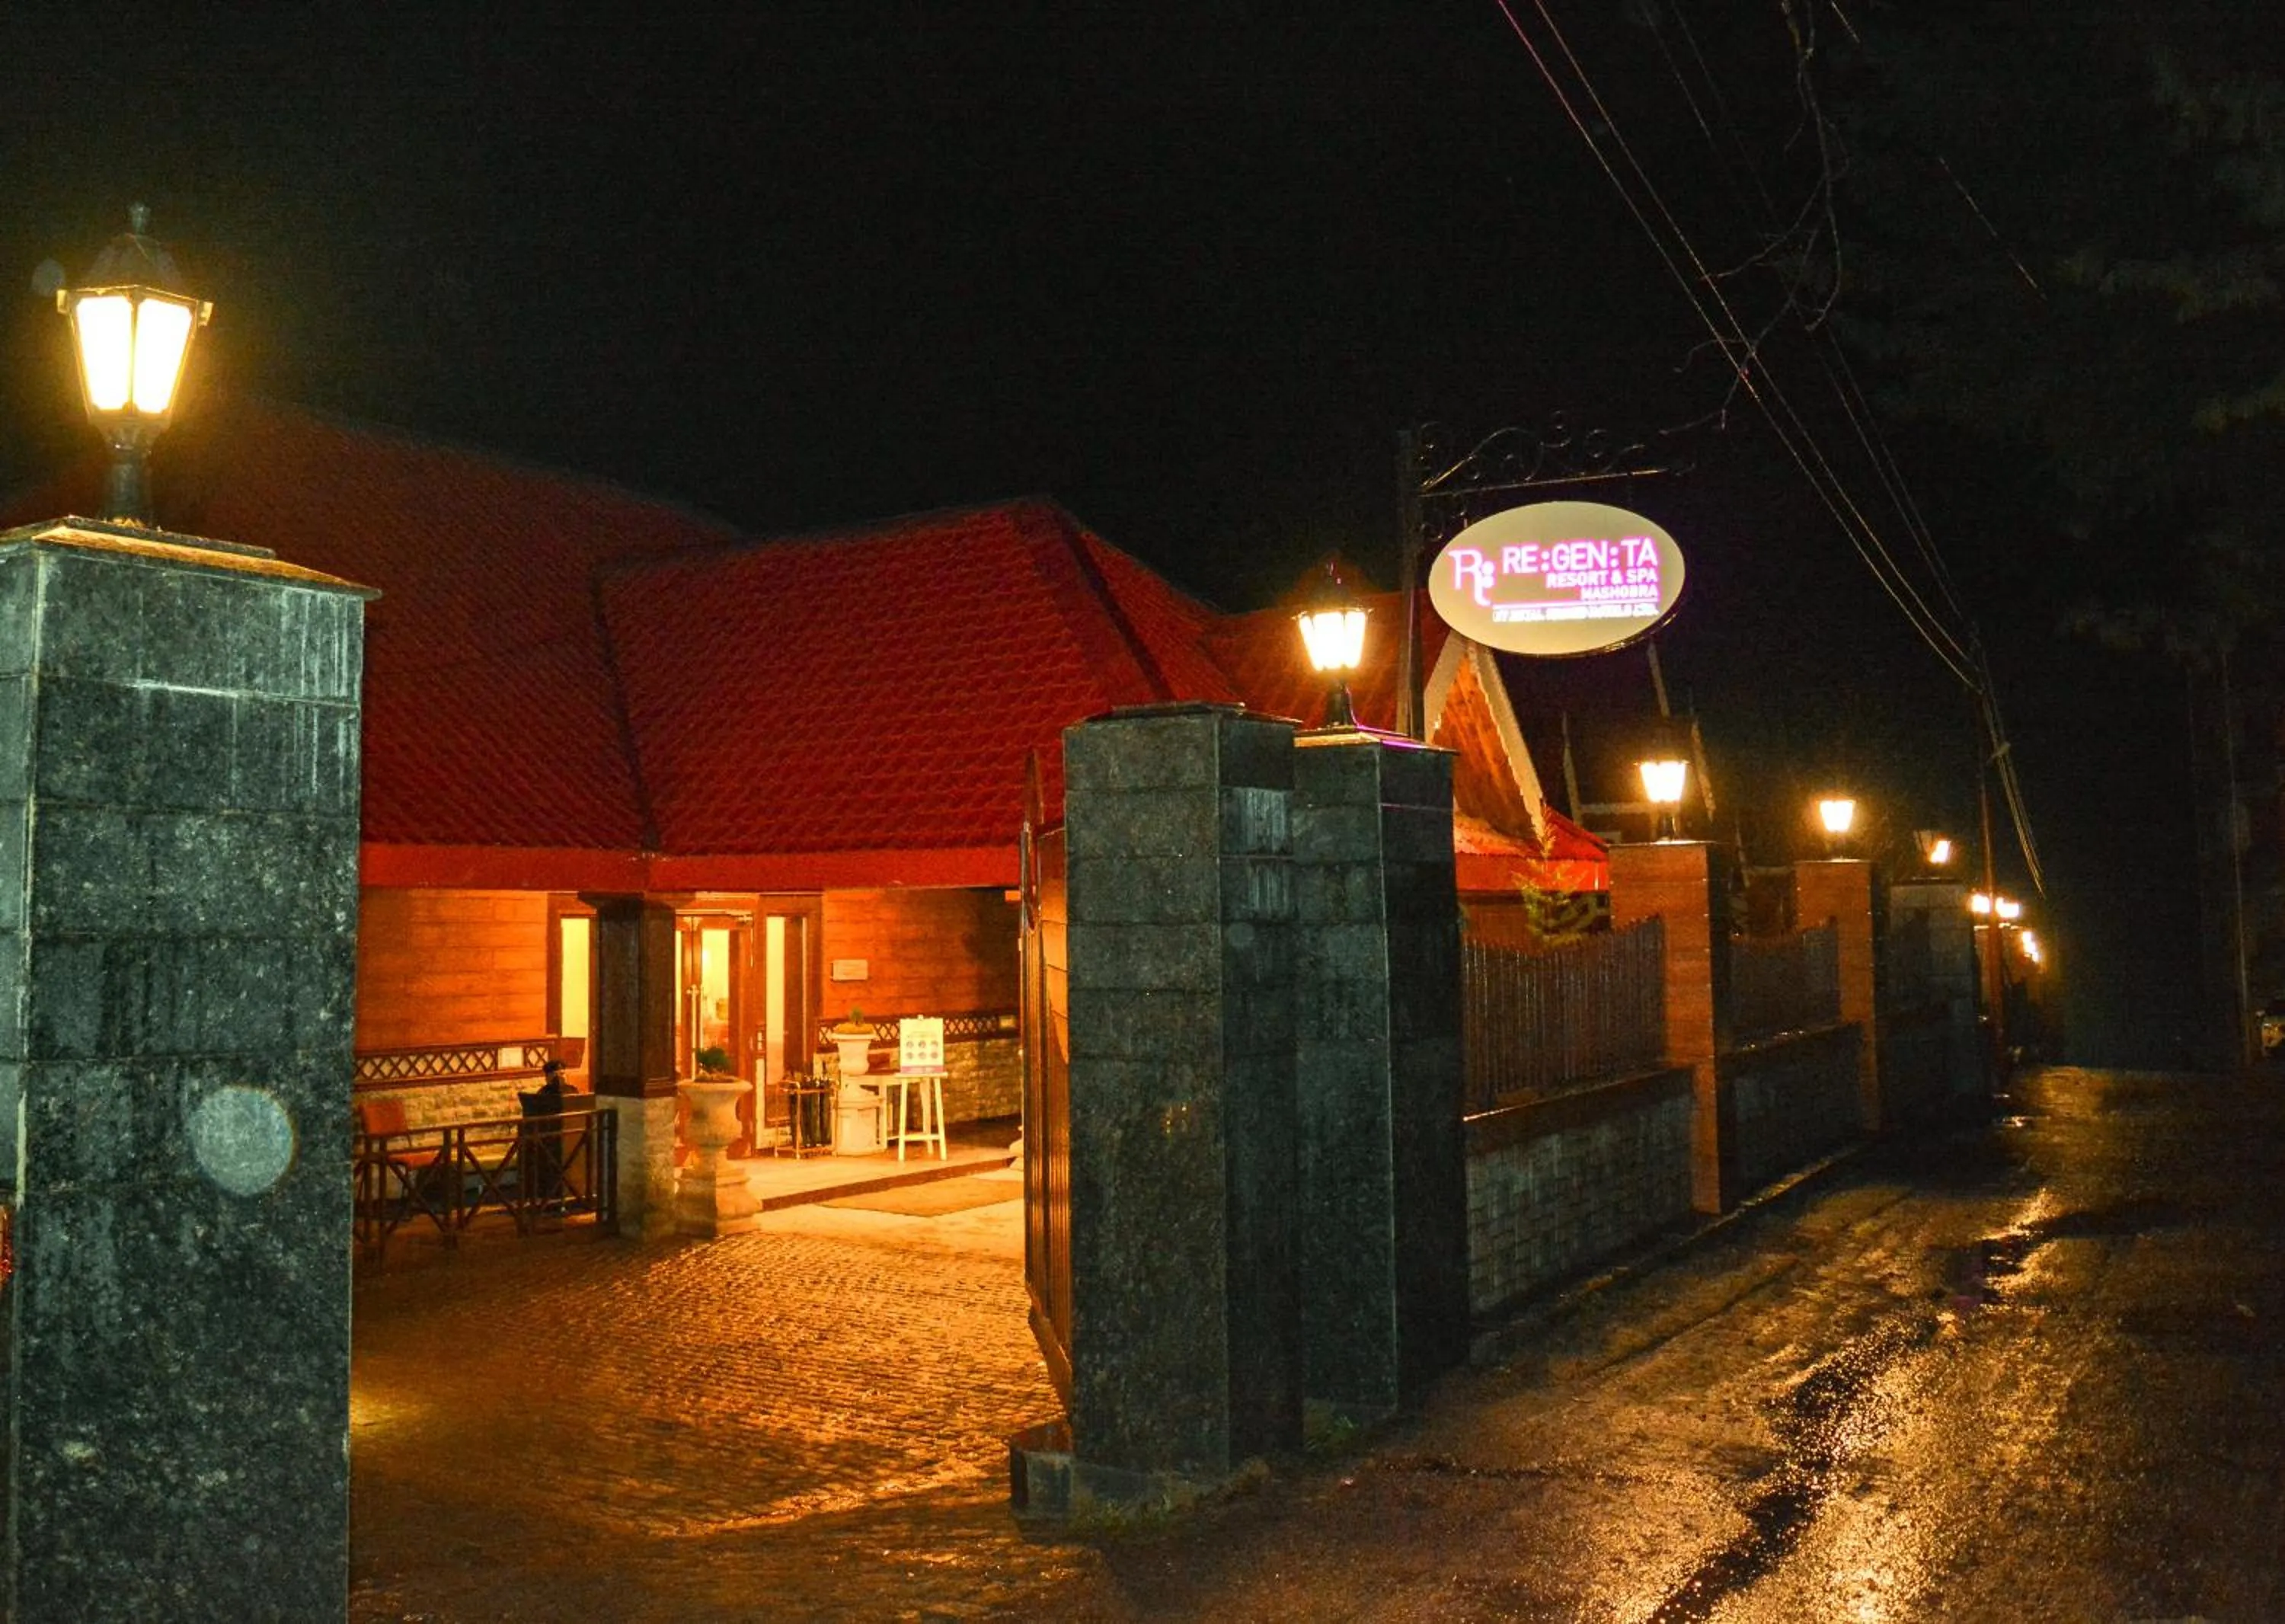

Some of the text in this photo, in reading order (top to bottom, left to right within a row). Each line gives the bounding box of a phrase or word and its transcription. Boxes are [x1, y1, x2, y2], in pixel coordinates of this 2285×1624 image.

[1546, 568, 1658, 587] RESORT & SPA
